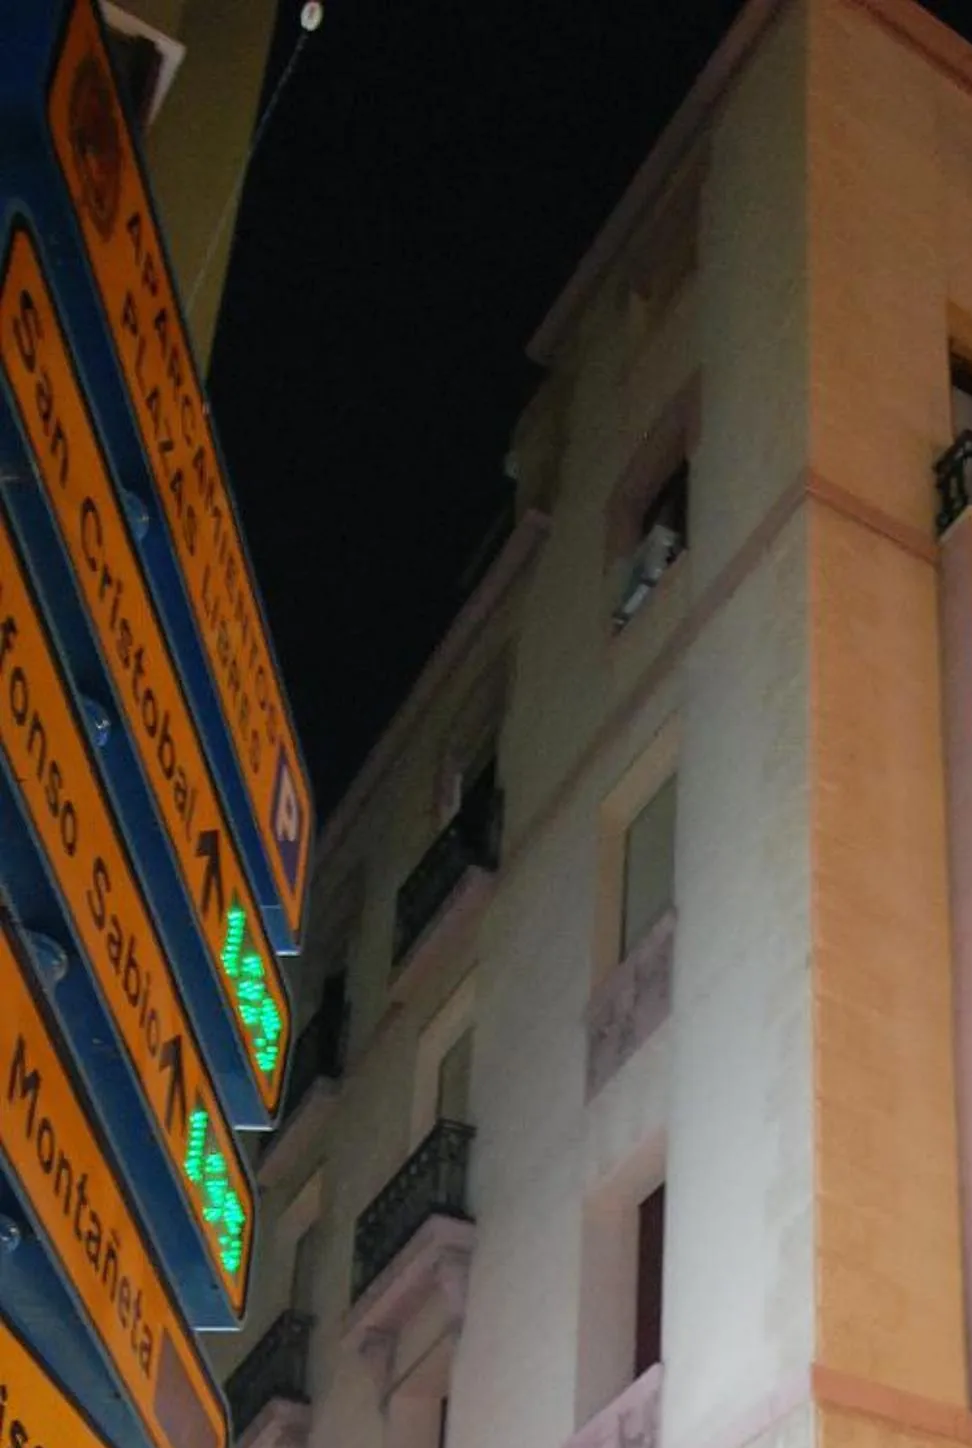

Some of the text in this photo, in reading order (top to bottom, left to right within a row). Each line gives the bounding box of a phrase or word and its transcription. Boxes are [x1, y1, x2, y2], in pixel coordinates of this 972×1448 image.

[12, 288, 198, 842] San Cristobal
[121, 290, 260, 775] PLAZAS LIBRES
[126, 212, 277, 745] APARCAMIENTOS
[86, 856, 159, 1058] Sabio
[7, 1031, 155, 1380] Montañeta
